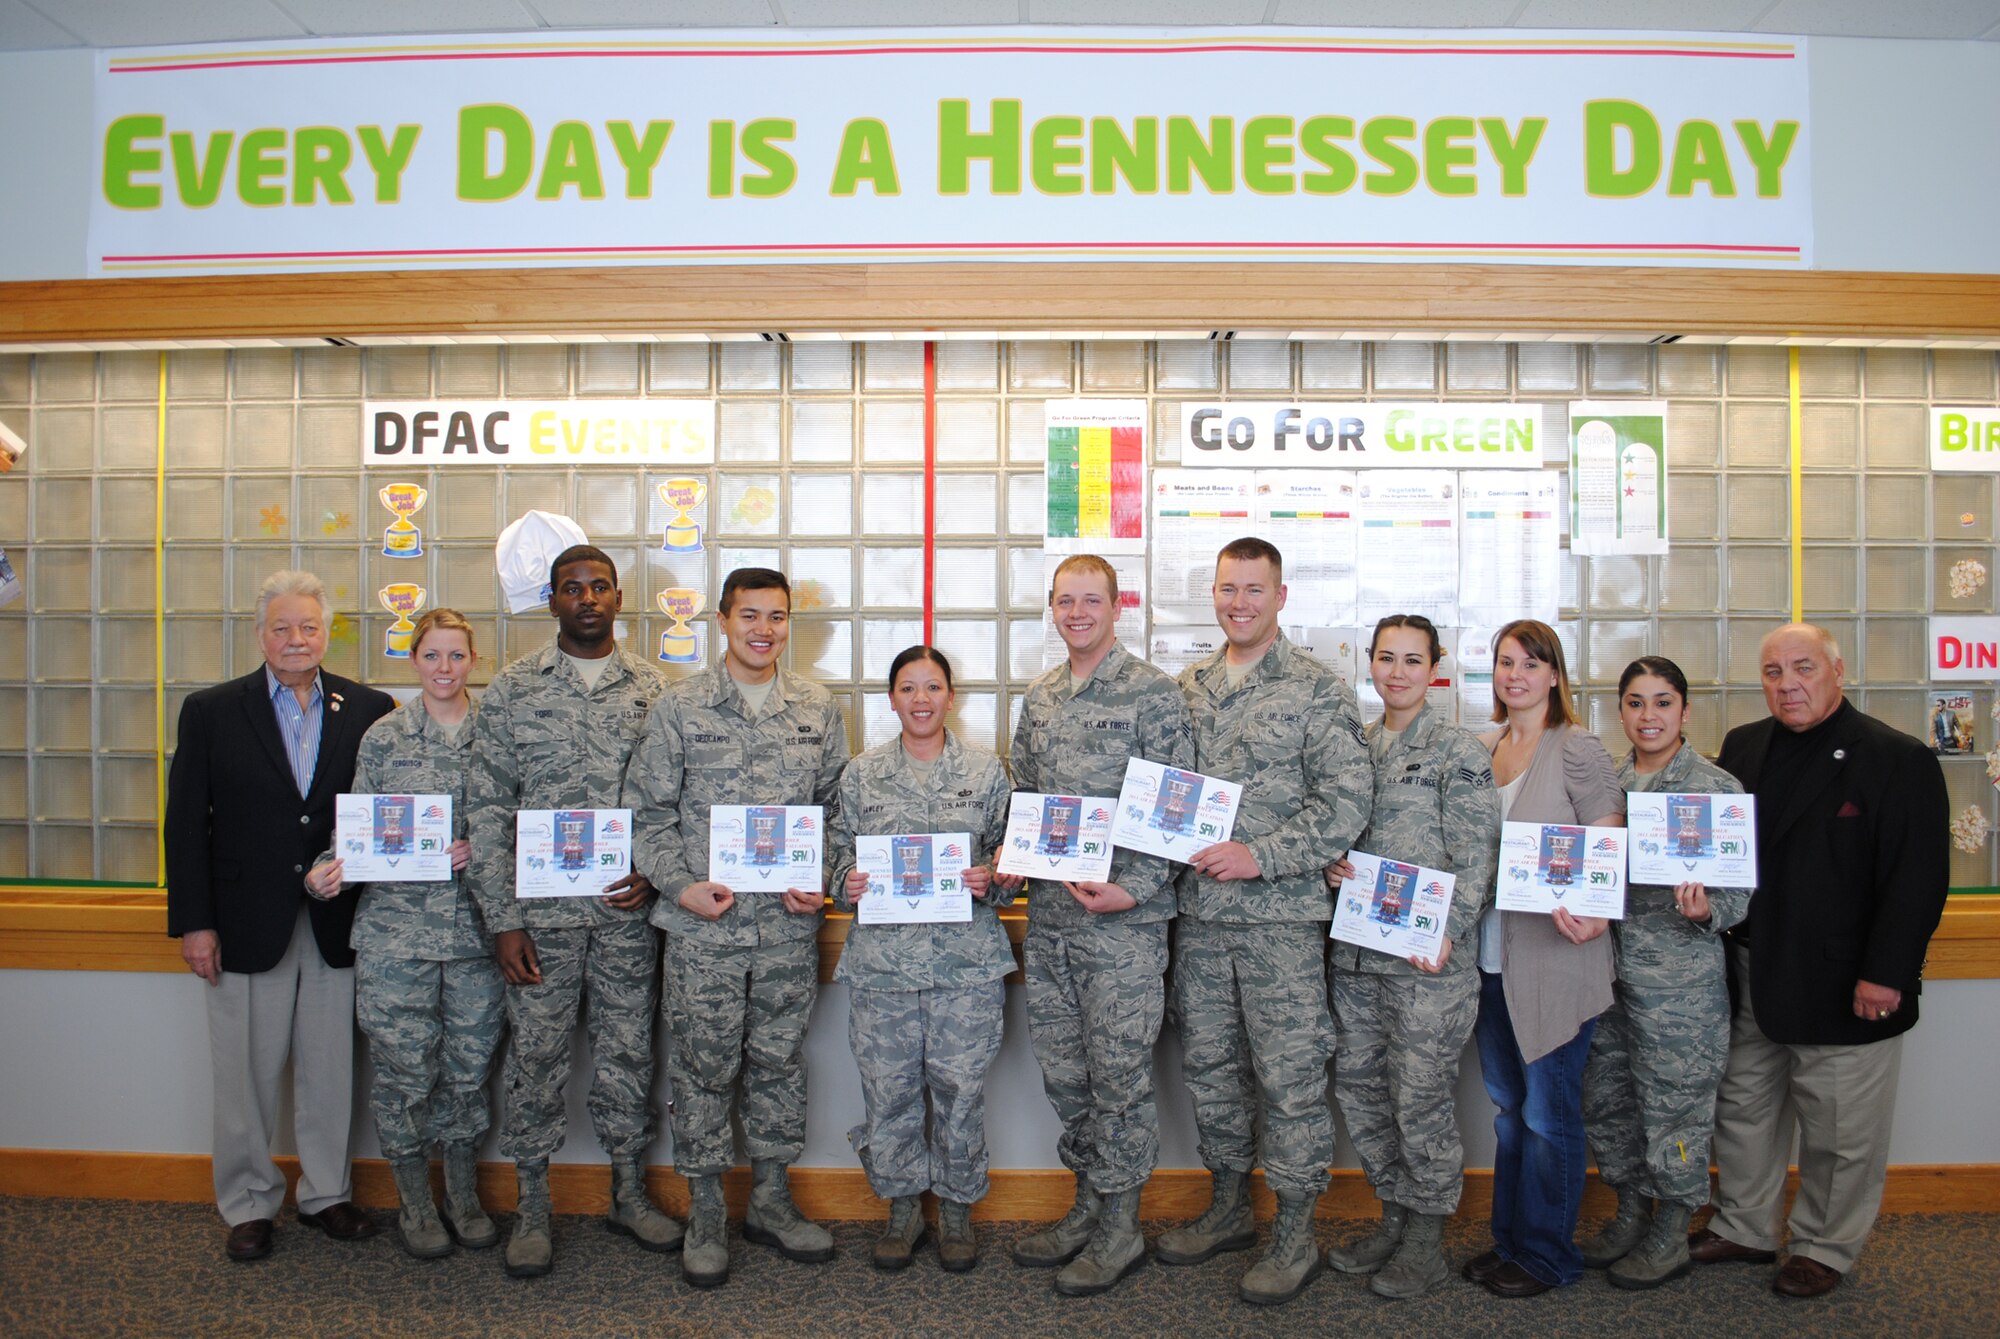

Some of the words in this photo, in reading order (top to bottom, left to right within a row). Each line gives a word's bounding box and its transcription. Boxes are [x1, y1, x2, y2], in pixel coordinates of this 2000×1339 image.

[103, 114, 421, 210] EVERY
[457, 104, 674, 202] DAY
[709, 118, 797, 198] IS
[830, 118, 901, 196] A
[938, 99, 1548, 196] HENNESSEY
[1585, 99, 1799, 198] DAY
[374, 411, 509, 455] DFAC
[529, 410, 706, 455] EVENTS
[1190, 408, 1255, 451] GO
[1274, 408, 1366, 452] FOR
[1383, 409, 1534, 453] GREEN
[668, 487, 692, 497] Great
[389, 493, 412, 502] Great
[676, 496, 695, 506] Job!
[397, 502, 416, 510] Job!
[389, 592, 412, 602] Great
[667, 597, 691, 606] Great
[397, 602, 416, 610] Job!
[674, 606, 694, 615] Job!
[1938, 636, 1997, 669] DIN
[535, 710, 552, 718] FORD
[1281, 712, 1301, 722] FORCE
[1096, 720, 1107, 730] AIR
[1110, 721, 1130, 731] FORCE
[1400, 776, 1412, 784] AIR
[1416, 776, 1437, 788] FORCE
